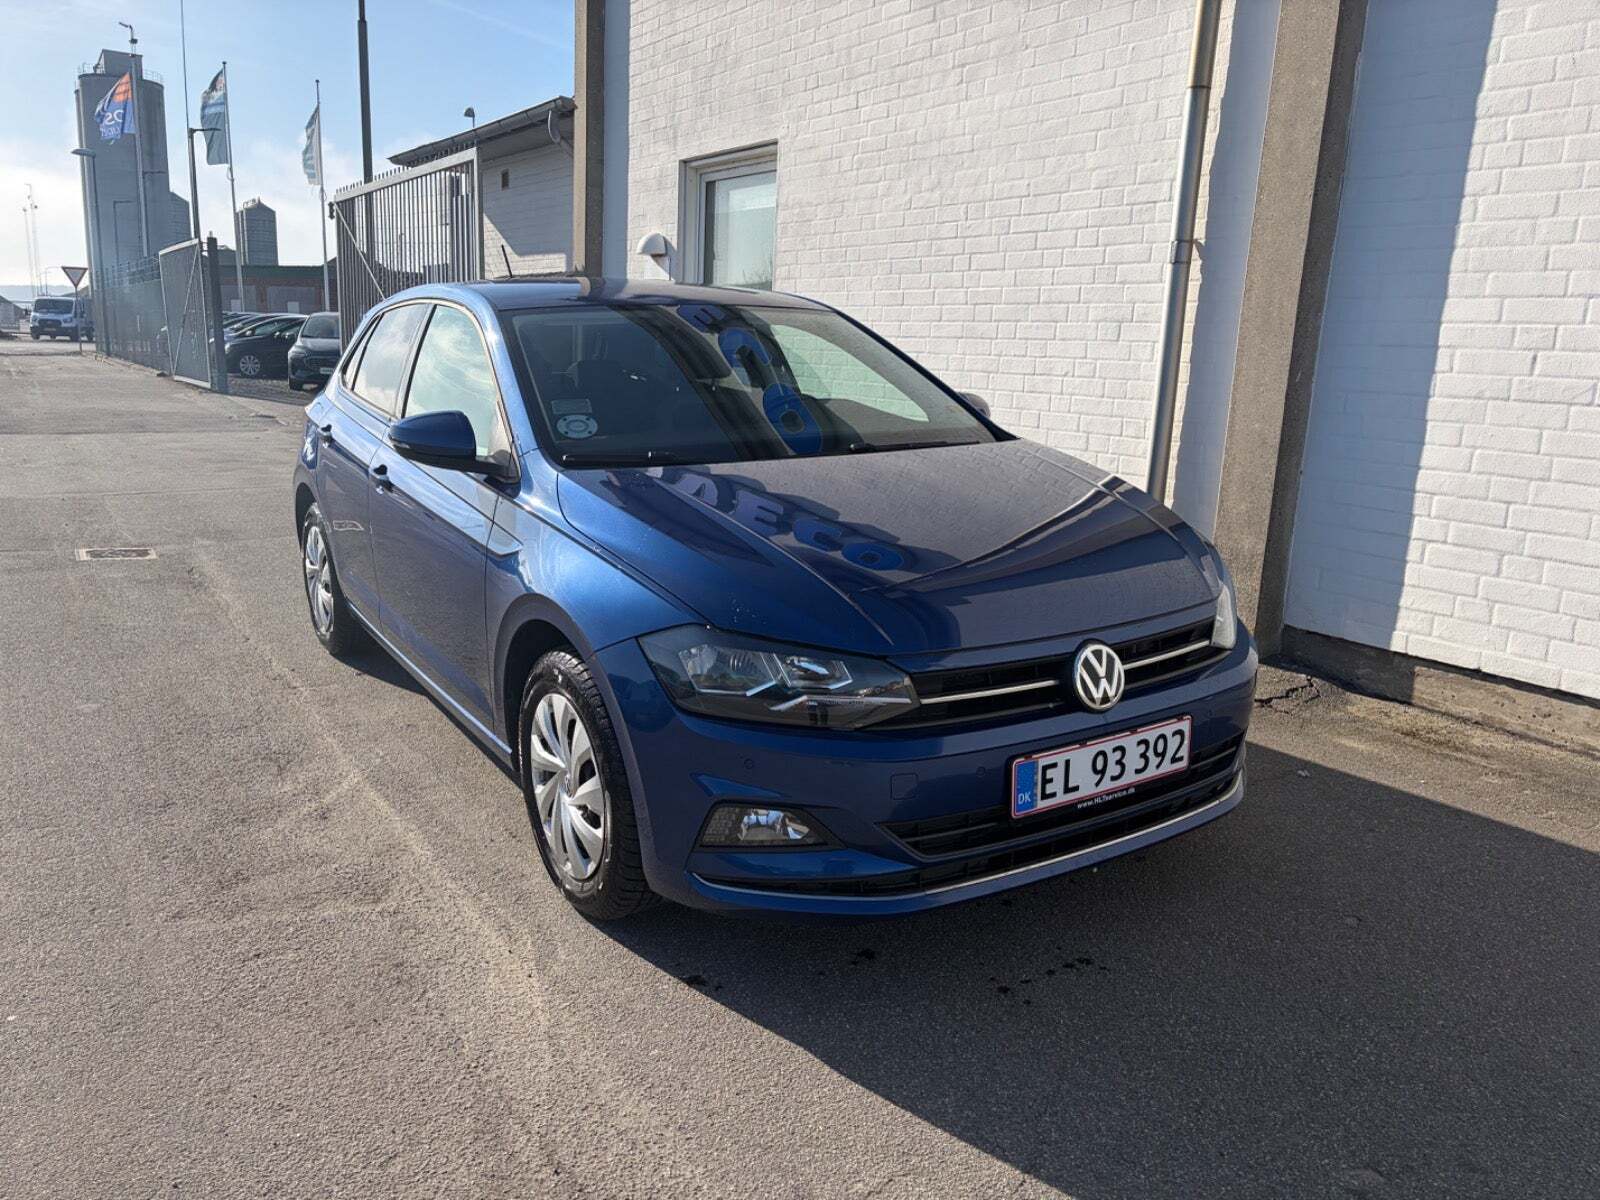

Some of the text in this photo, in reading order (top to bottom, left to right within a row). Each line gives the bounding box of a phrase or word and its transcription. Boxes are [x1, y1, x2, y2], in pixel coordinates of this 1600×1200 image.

[1040, 728, 1186, 801] EL 93 392
[1018, 791, 1032, 805] DK
